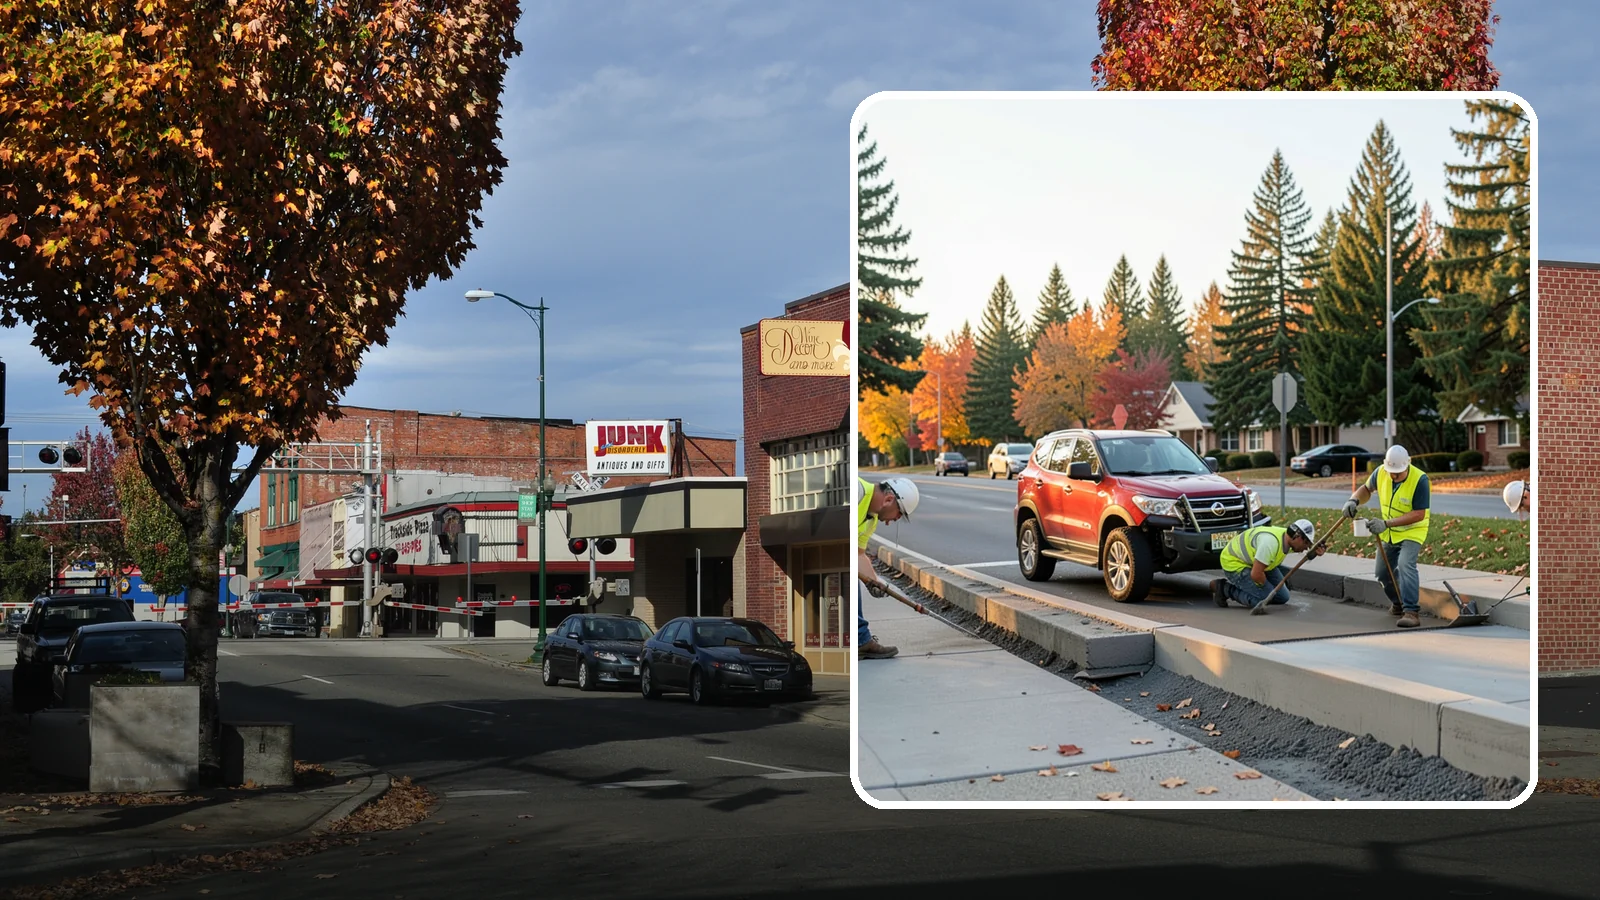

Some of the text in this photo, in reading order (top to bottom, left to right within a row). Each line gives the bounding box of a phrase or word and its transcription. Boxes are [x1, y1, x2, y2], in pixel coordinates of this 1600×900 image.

[595, 425, 665, 457] JUNK
[607, 446, 645, 454] DISORDERLY
[597, 461, 665, 470] ANTIQUES AND GIFTS
[414, 519, 429, 535] Pizza
